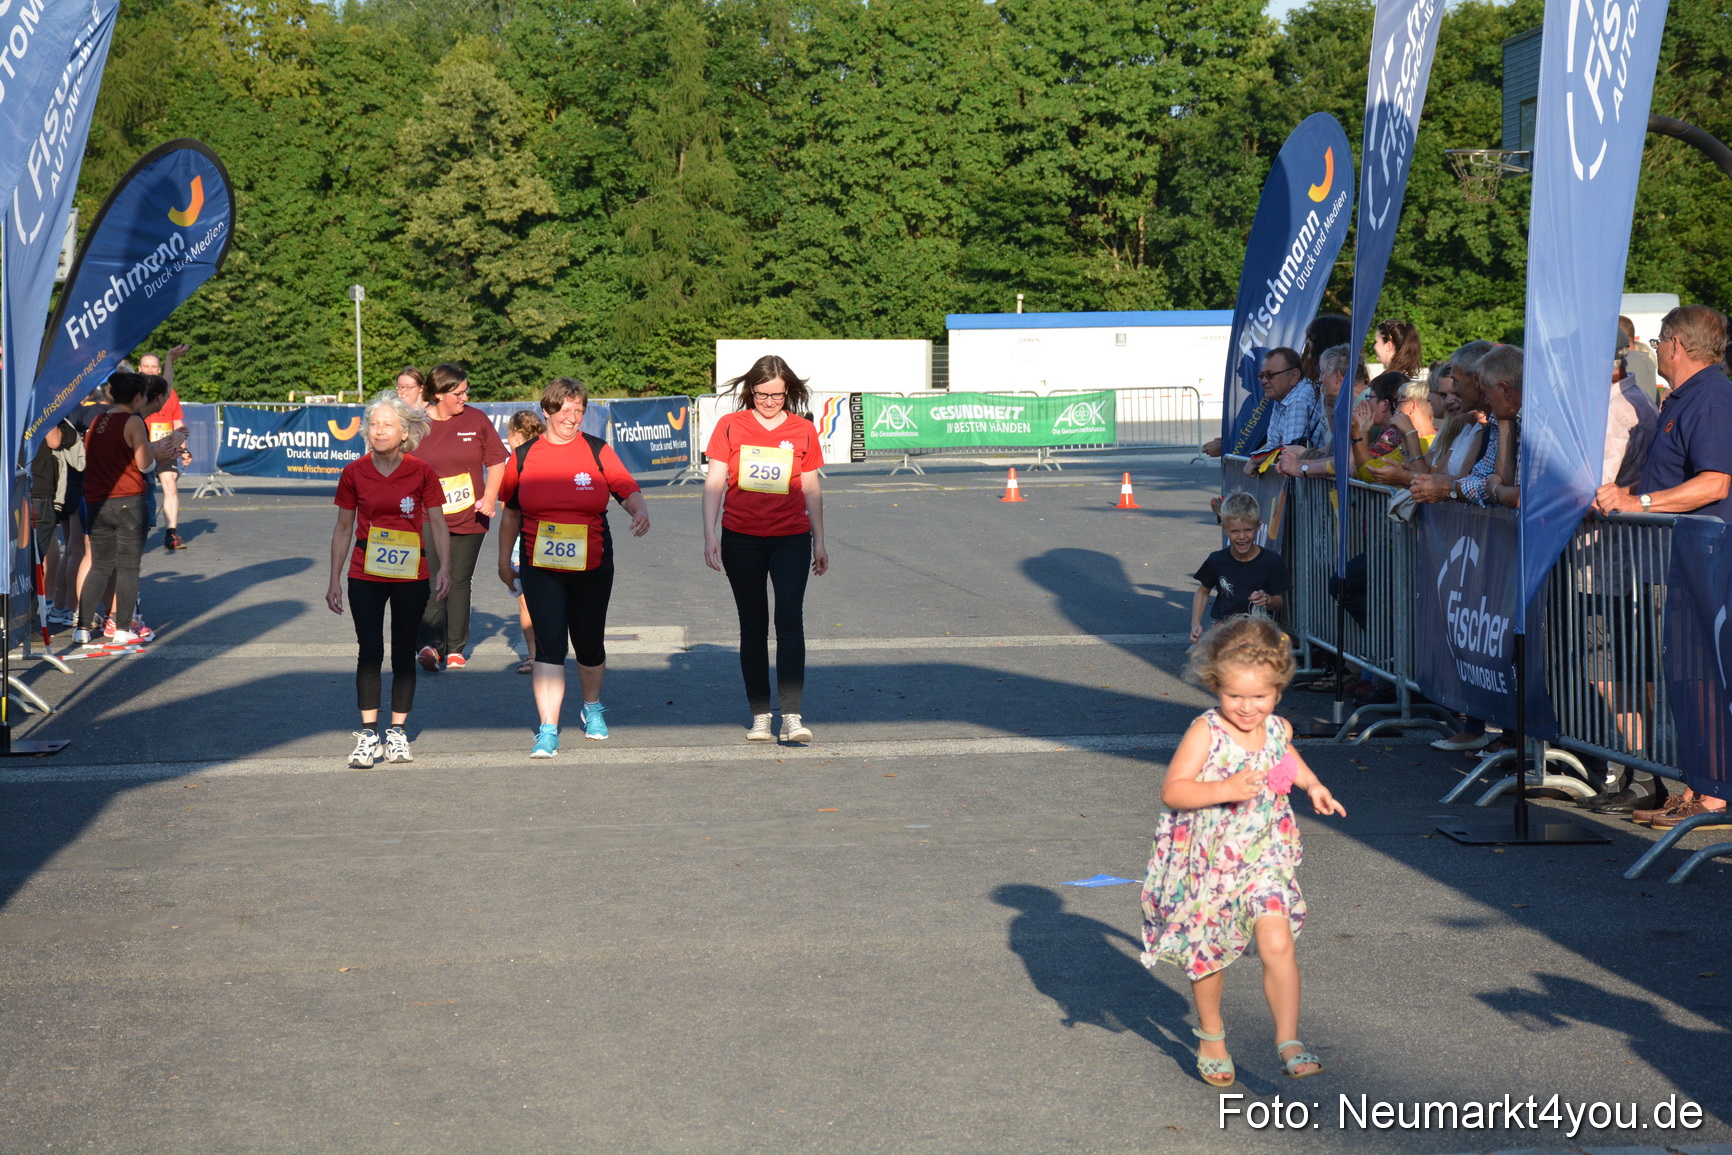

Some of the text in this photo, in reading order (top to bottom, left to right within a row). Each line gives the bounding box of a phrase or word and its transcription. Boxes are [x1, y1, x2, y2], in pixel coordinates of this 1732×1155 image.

[1613, 0, 1641, 124] AUTO
[1380, 0, 1425, 187] Fisch
[1296, 190, 1347, 291] Druck und Medien
[144, 267, 173, 299] Druck
[190, 221, 225, 259] Medien
[65, 231, 185, 350] Frischmann
[1238, 208, 1321, 362] Frischmann
[23, 349, 107, 441] www.frischmann-net.de
[872, 404, 918, 430] AOK
[930, 404, 1025, 421] GESUNDHEIT
[1053, 400, 1106, 427] AOK
[227, 426, 330, 450] Frischmann
[614, 420, 672, 442] Frischmann
[954, 421, 988, 433] BESTEN
[989, 420, 1031, 433] HÄNDEN
[286, 448, 361, 461] Druck und Medien
[650, 441, 663, 452] Druck
[663, 440, 672, 450] und
[749, 464, 781, 480] 259
[446, 487, 470, 504] 126
[376, 547, 410, 565] 267
[544, 541, 576, 557] 268
[1447, 589, 1509, 659] Fischer
